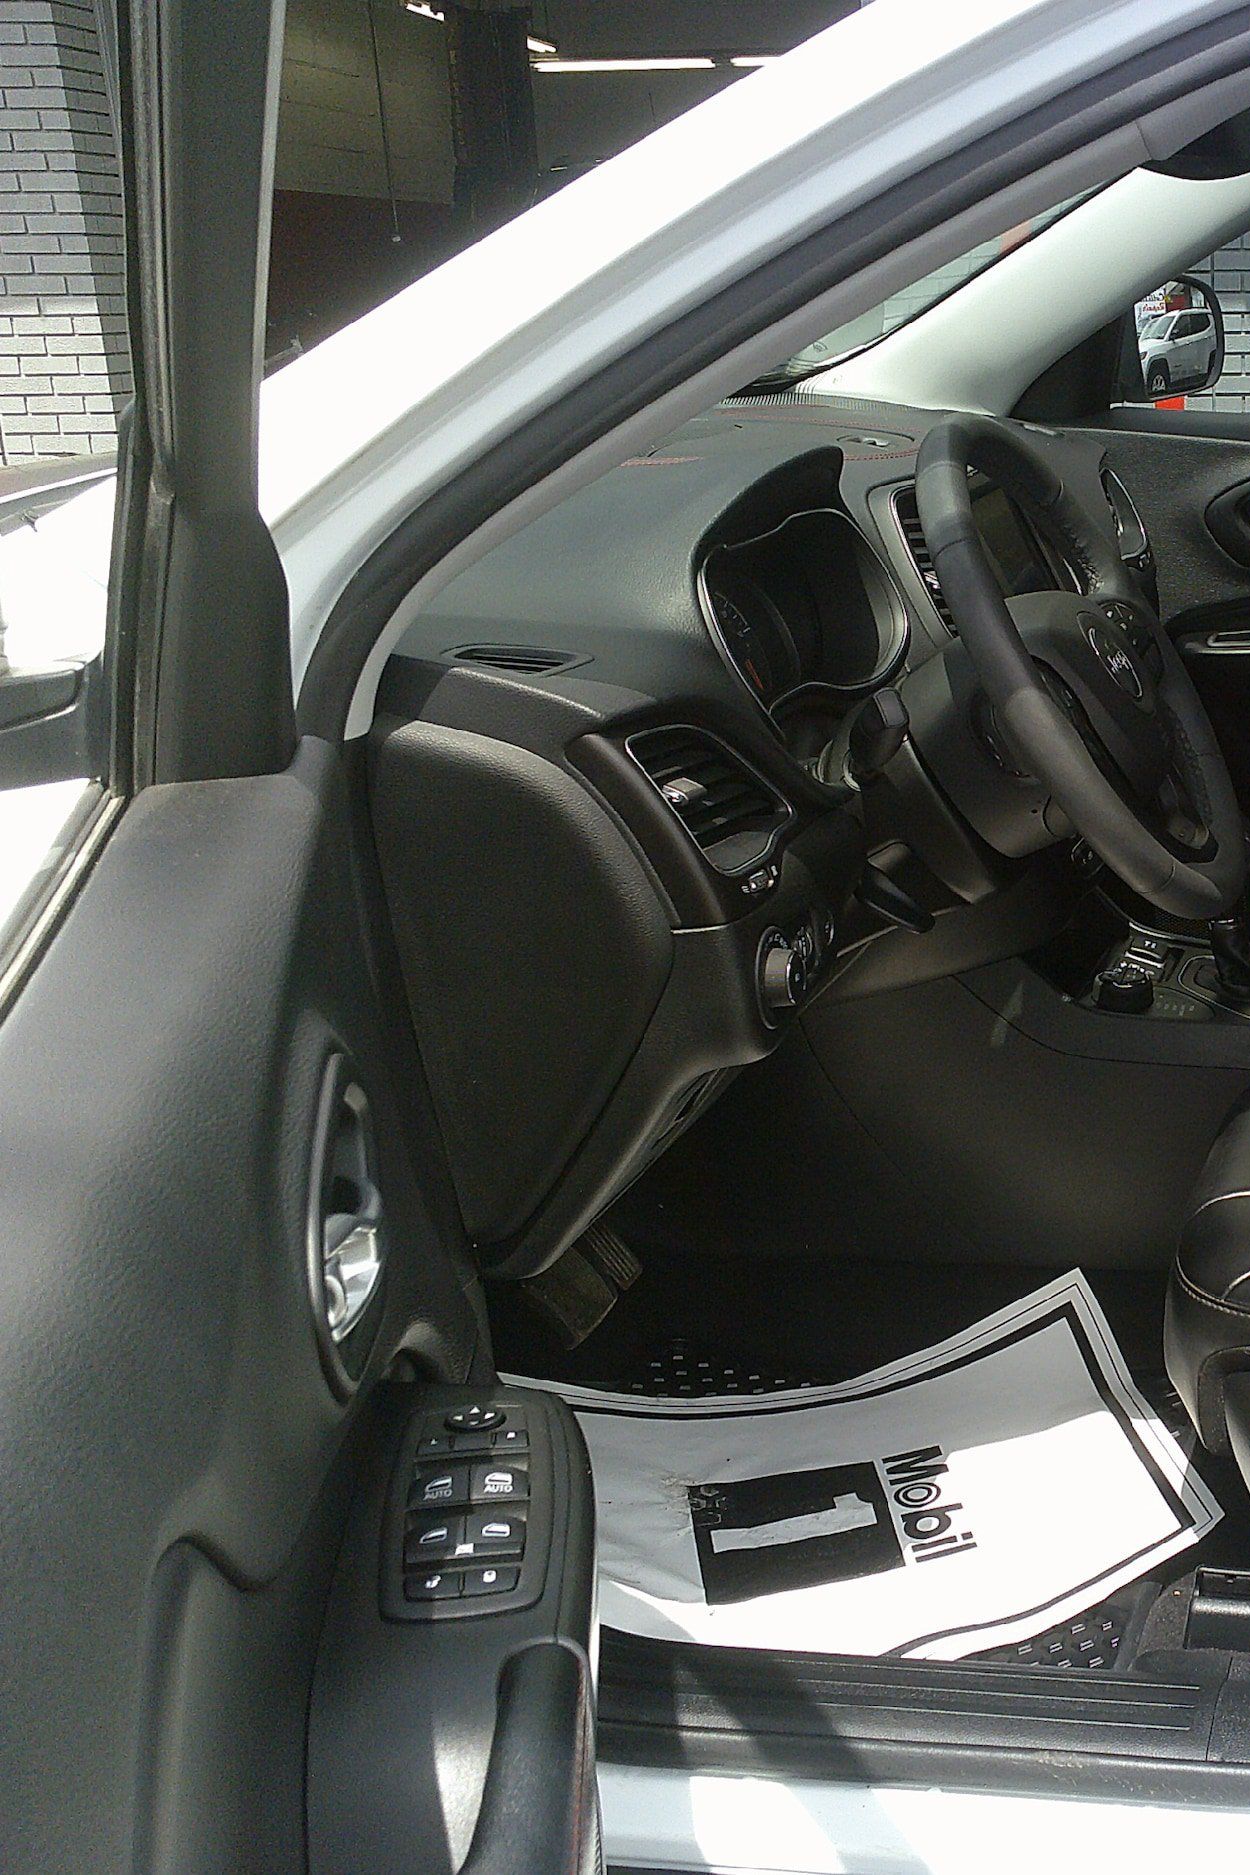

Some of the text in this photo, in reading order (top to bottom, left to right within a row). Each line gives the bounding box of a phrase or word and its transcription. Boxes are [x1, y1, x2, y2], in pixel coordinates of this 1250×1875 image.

[423, 1488, 453, 1500] AUTO
[484, 1483, 513, 1494] AUTO
[882, 1445, 977, 1563] Mobil
